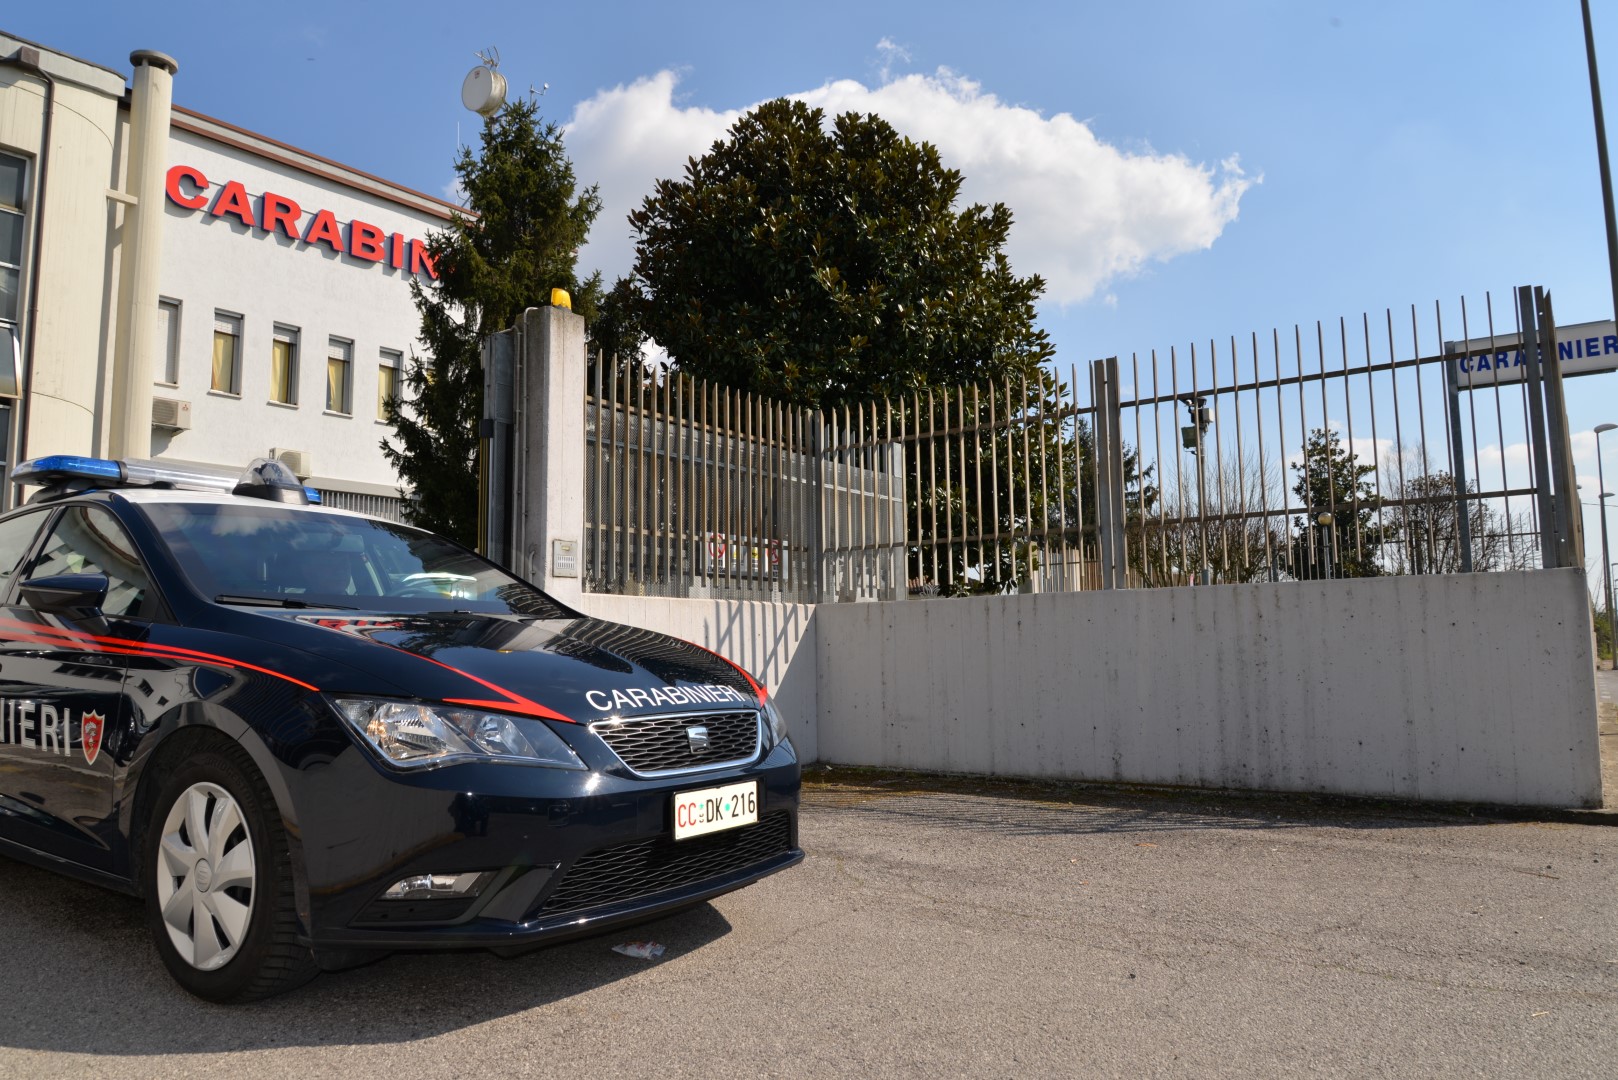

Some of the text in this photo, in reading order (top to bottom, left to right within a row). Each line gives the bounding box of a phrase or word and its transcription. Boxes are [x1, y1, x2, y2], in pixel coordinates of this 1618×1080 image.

[1459, 335, 1618, 374] CARANIER
[585, 684, 746, 711] CARABINIERI
[0, 698, 71, 757] IERI
[677, 791, 756, 828] CC DK 216
